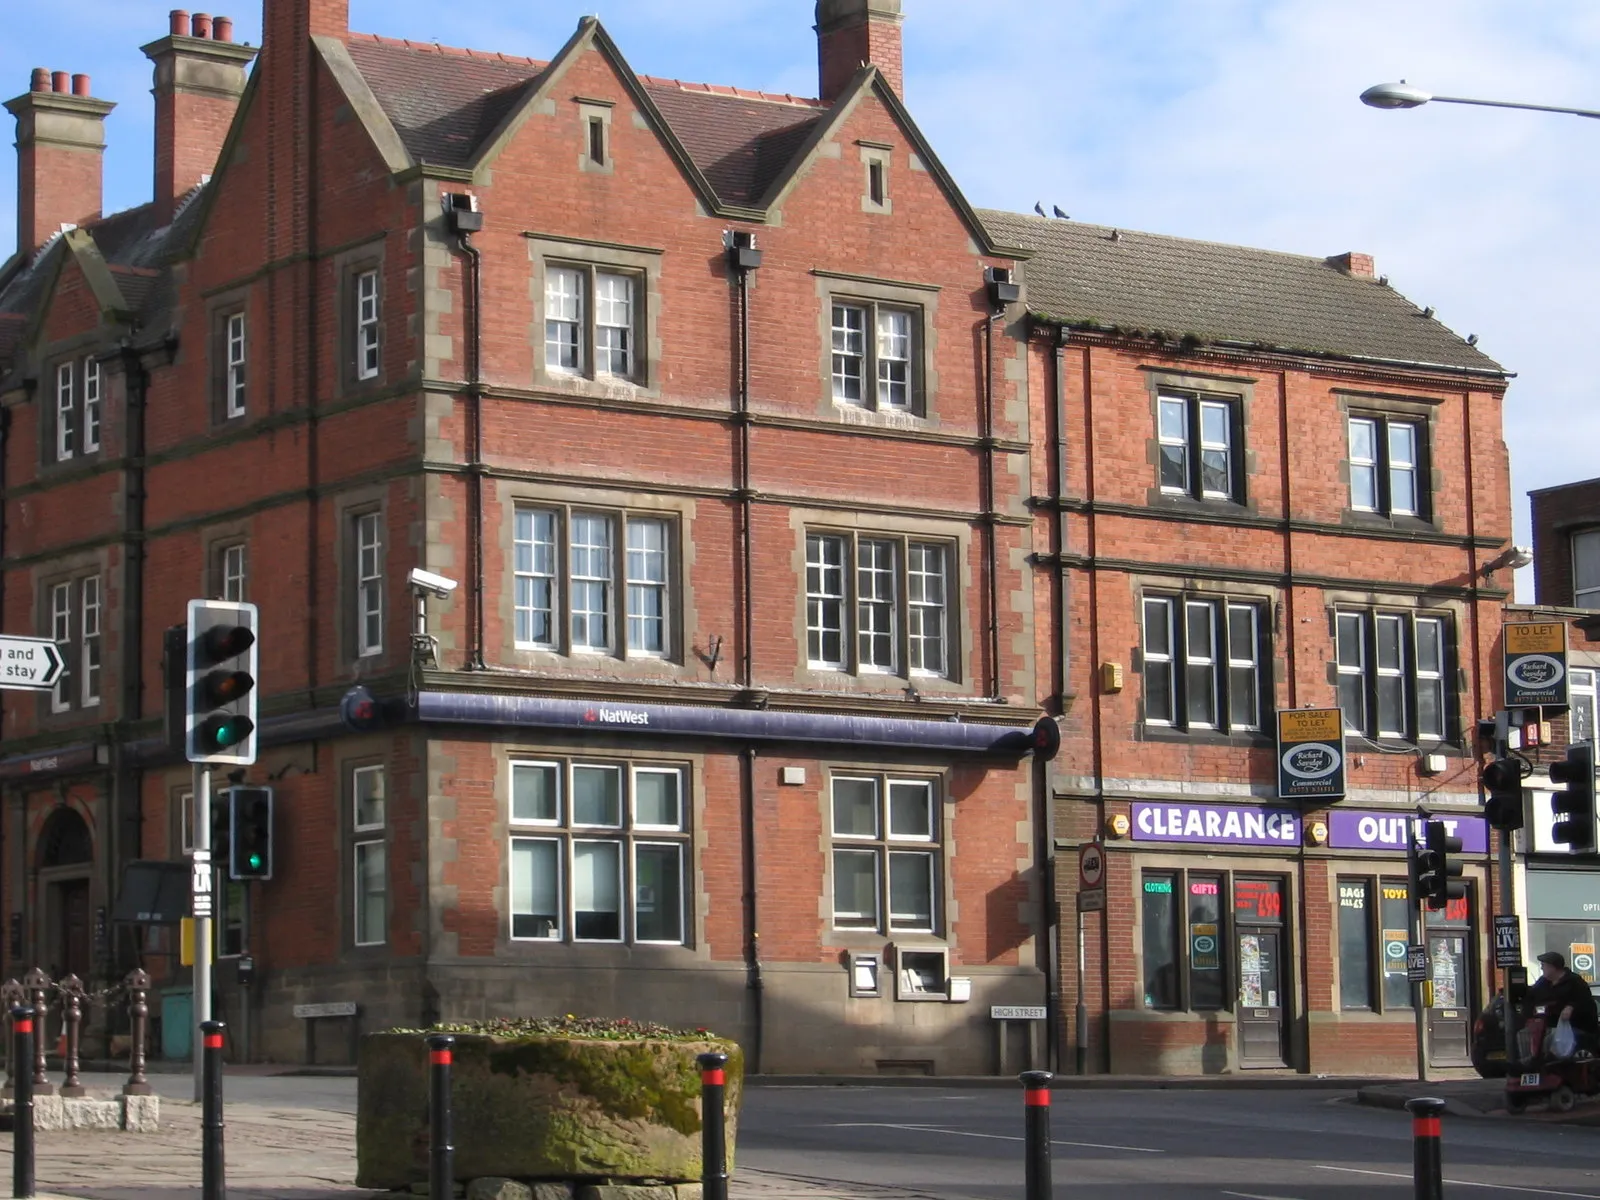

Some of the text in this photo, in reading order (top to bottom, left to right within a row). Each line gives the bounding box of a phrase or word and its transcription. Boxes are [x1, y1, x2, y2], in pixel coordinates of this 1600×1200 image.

[1514, 625, 1554, 635] TO LET
[8, 648, 34, 660] and
[6, 664, 37, 679] stay
[600, 708, 649, 724] NatWest
[1310, 719, 1326, 727] LET
[1577, 706, 1585, 743] NAIL
[1297, 750, 1323, 759] Richard
[1292, 778, 1332, 787] Commercial
[1137, 807, 1295, 840] CLEARANCE
[1358, 816, 1458, 845] OUTLT
[1144, 882, 1172, 893] CLOTHING
[1191, 883, 1217, 895] GIFTS
[1340, 887, 1365, 898] BAGS
[1383, 888, 1408, 899] TOYS
[1340, 898, 1364, 909] ALL £5
[994, 1007, 1044, 1017] HIGH STREET
